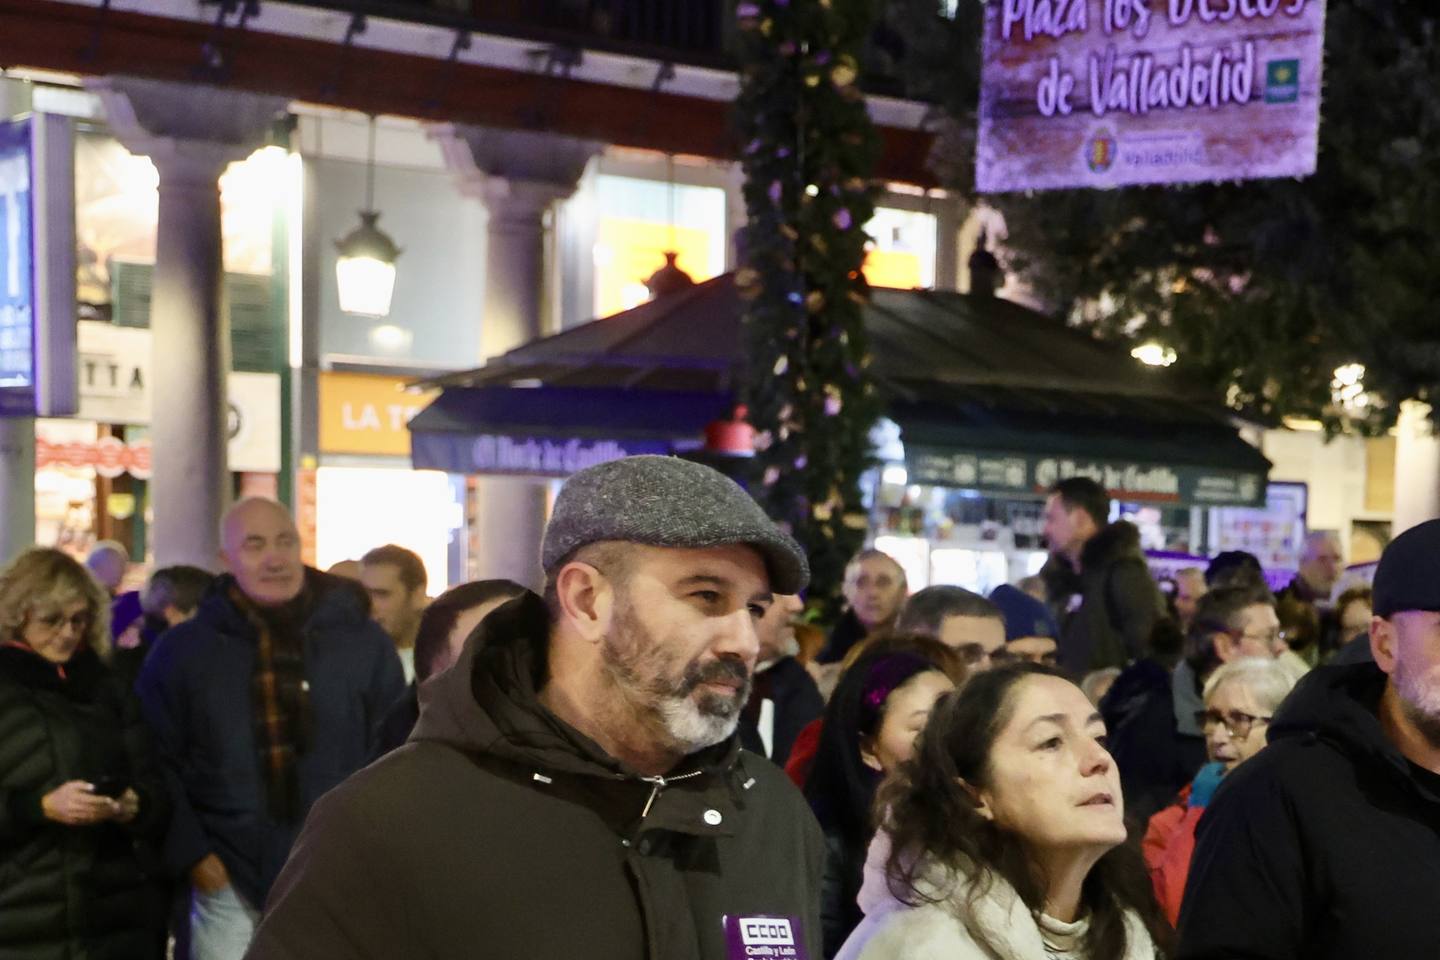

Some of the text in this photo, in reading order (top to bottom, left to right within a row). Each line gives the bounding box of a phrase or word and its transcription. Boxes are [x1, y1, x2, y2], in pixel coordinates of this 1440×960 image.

[1037, 42, 1254, 117] de Valladolid
[341, 402, 381, 431] LA
[747, 924, 788, 939] CCOO
